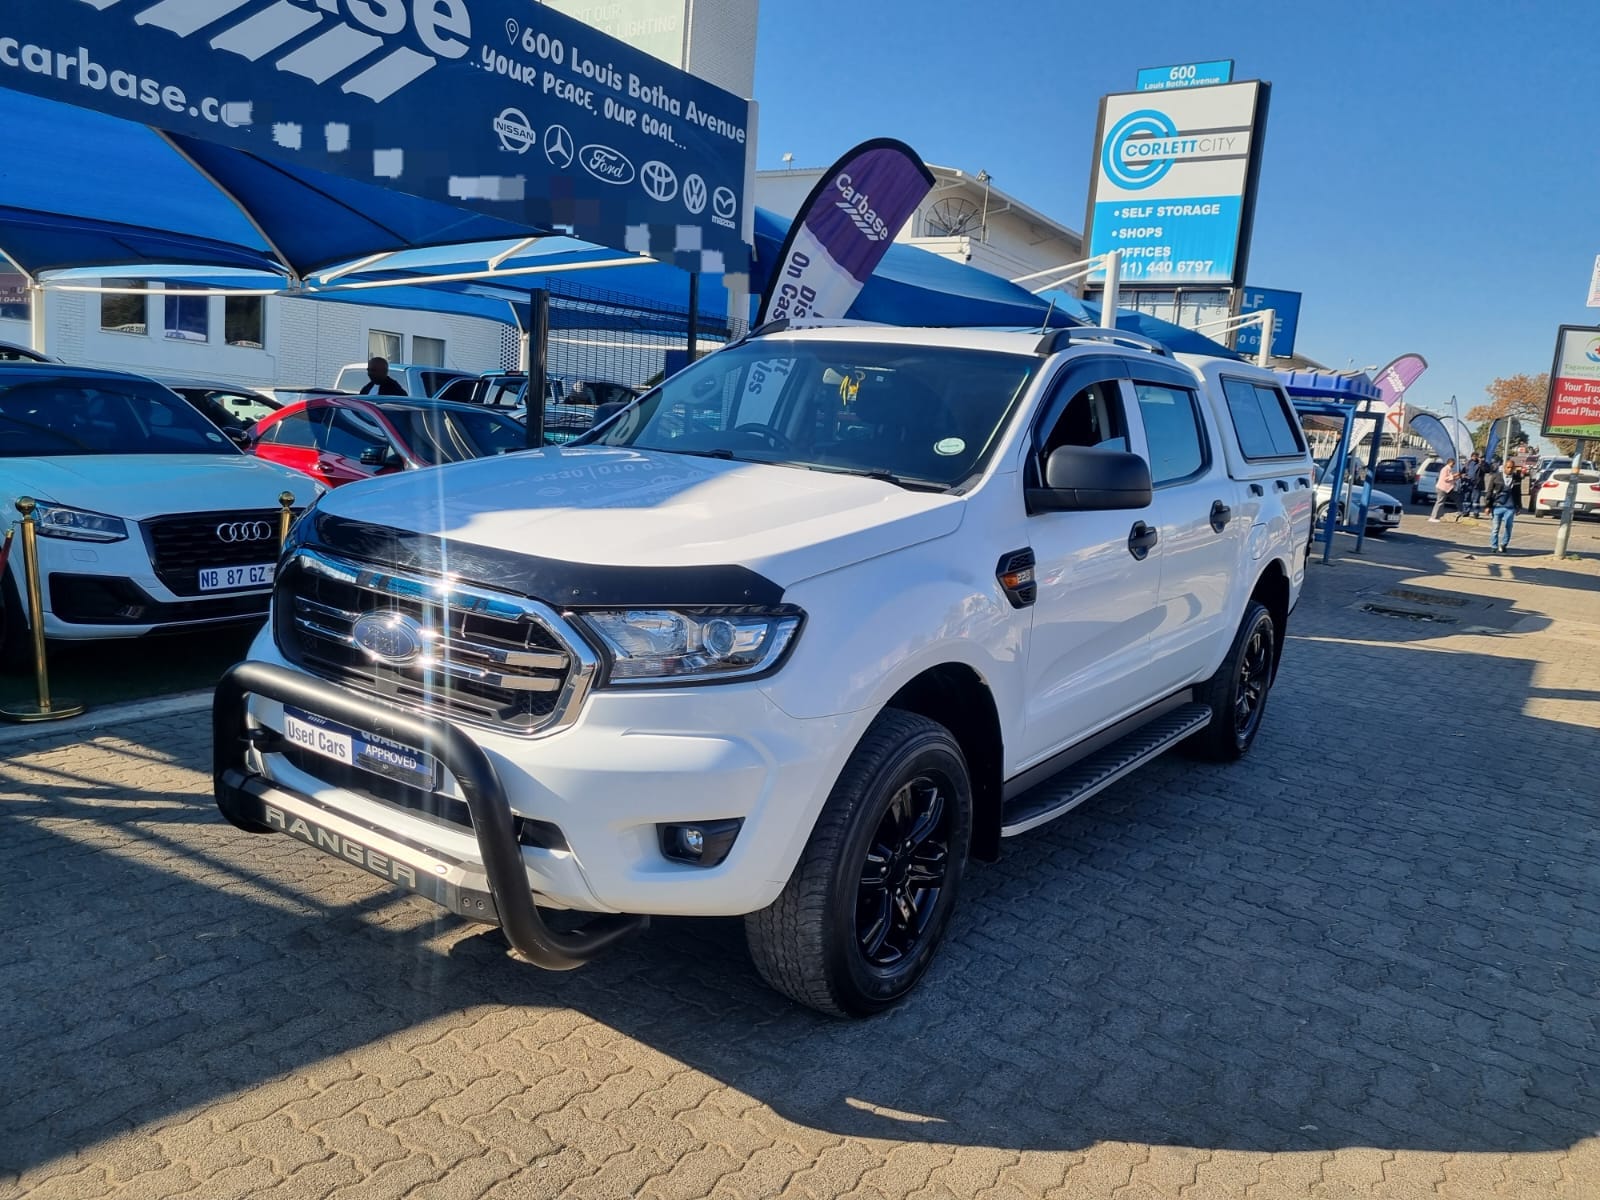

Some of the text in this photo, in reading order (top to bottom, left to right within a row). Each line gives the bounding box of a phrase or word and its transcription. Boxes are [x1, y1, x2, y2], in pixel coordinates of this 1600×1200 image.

[1169, 65, 1196, 80] 600
[522, 27, 746, 144] 600 Louis Botha Avenue
[1144, 77, 1220, 90] Louis Botha Avenue
[544, 72, 598, 116] PEACE,
[604, 97, 636, 127] OUR
[496, 121, 534, 141] NISSAN
[590, 150, 625, 178] Ford
[835, 173, 888, 241] Carbase
[1121, 204, 1220, 218] SELF STORAGE
[1119, 227, 1163, 239] SHOPS
[1146, 261, 1173, 273] 440
[1177, 261, 1213, 273] 6797
[772, 251, 810, 322] On Cas
[1564, 382, 1583, 391] Your
[1558, 394, 1591, 405] Longest
[1556, 405, 1579, 416] Local
[201, 567, 265, 588] NB 87 GZ
[288, 720, 346, 758] Used Cars
[365, 744, 417, 769] APPROVED
[265, 805, 416, 888] RANGER
